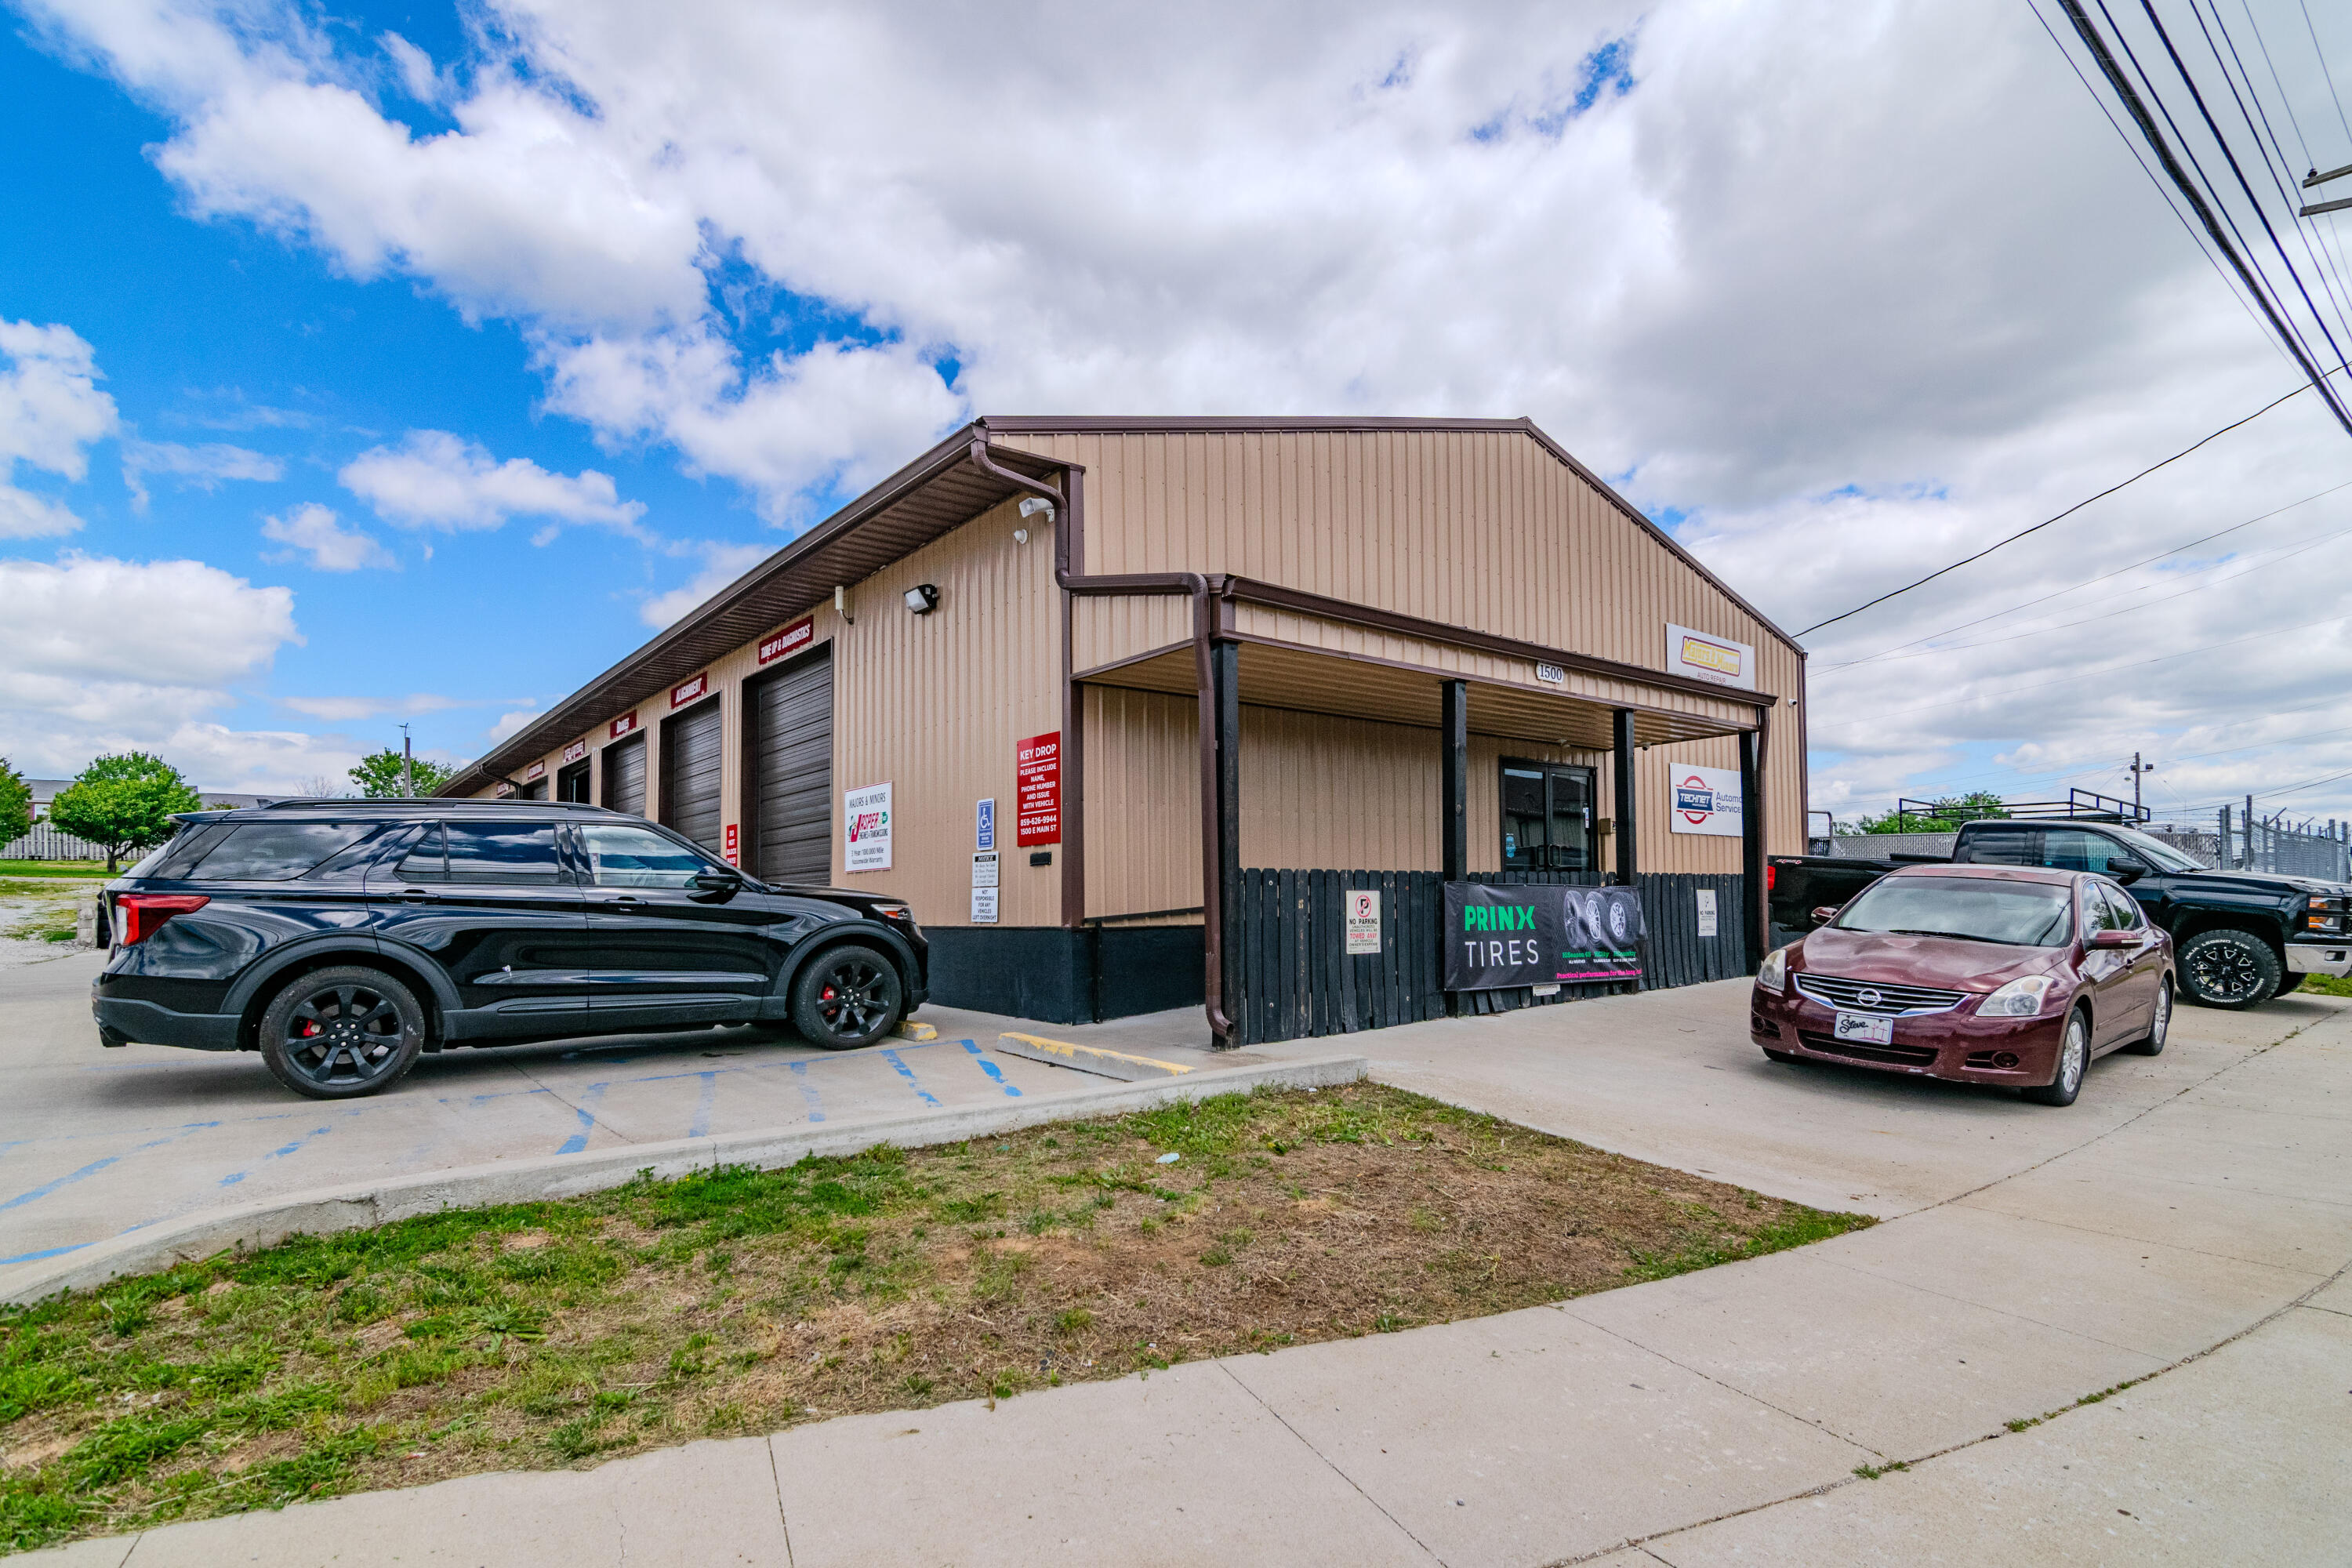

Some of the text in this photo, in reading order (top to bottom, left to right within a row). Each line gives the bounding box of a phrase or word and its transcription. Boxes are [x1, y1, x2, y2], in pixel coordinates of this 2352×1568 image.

[782, 623, 810, 648] DIAGNOSTICS
[1683, 639, 1710, 662] Majors
[1717, 653, 1739, 673] Minors
[1541, 665, 1562, 681] 1500
[1697, 671, 1726, 684] AUTO REPAIR
[675, 677, 702, 704] ALIGNMENT
[1020, 743, 1056, 760] KEY DROP
[1020, 763, 1057, 776] PLEASE INCLUDE
[1036, 781, 1055, 789] NUMBER
[849, 792, 885, 808] MAJORS & MINORS
[1035, 799, 1054, 808] VEHICLE
[1716, 803, 1741, 813] Service
[851, 812, 879, 842] JASPER
[1021, 815, 1057, 826] 859-626-9944
[1036, 825, 1049, 833] MAIN
[1465, 906, 1536, 931] PRINX
[2235, 941, 2251, 949] EXP
[1465, 939, 1539, 967] TIRES
[2185, 947, 2200, 960] BAJA
[2199, 978, 2265, 1003] MICKEY THOMPSON
[1839, 1019, 1868, 1033] Steve
